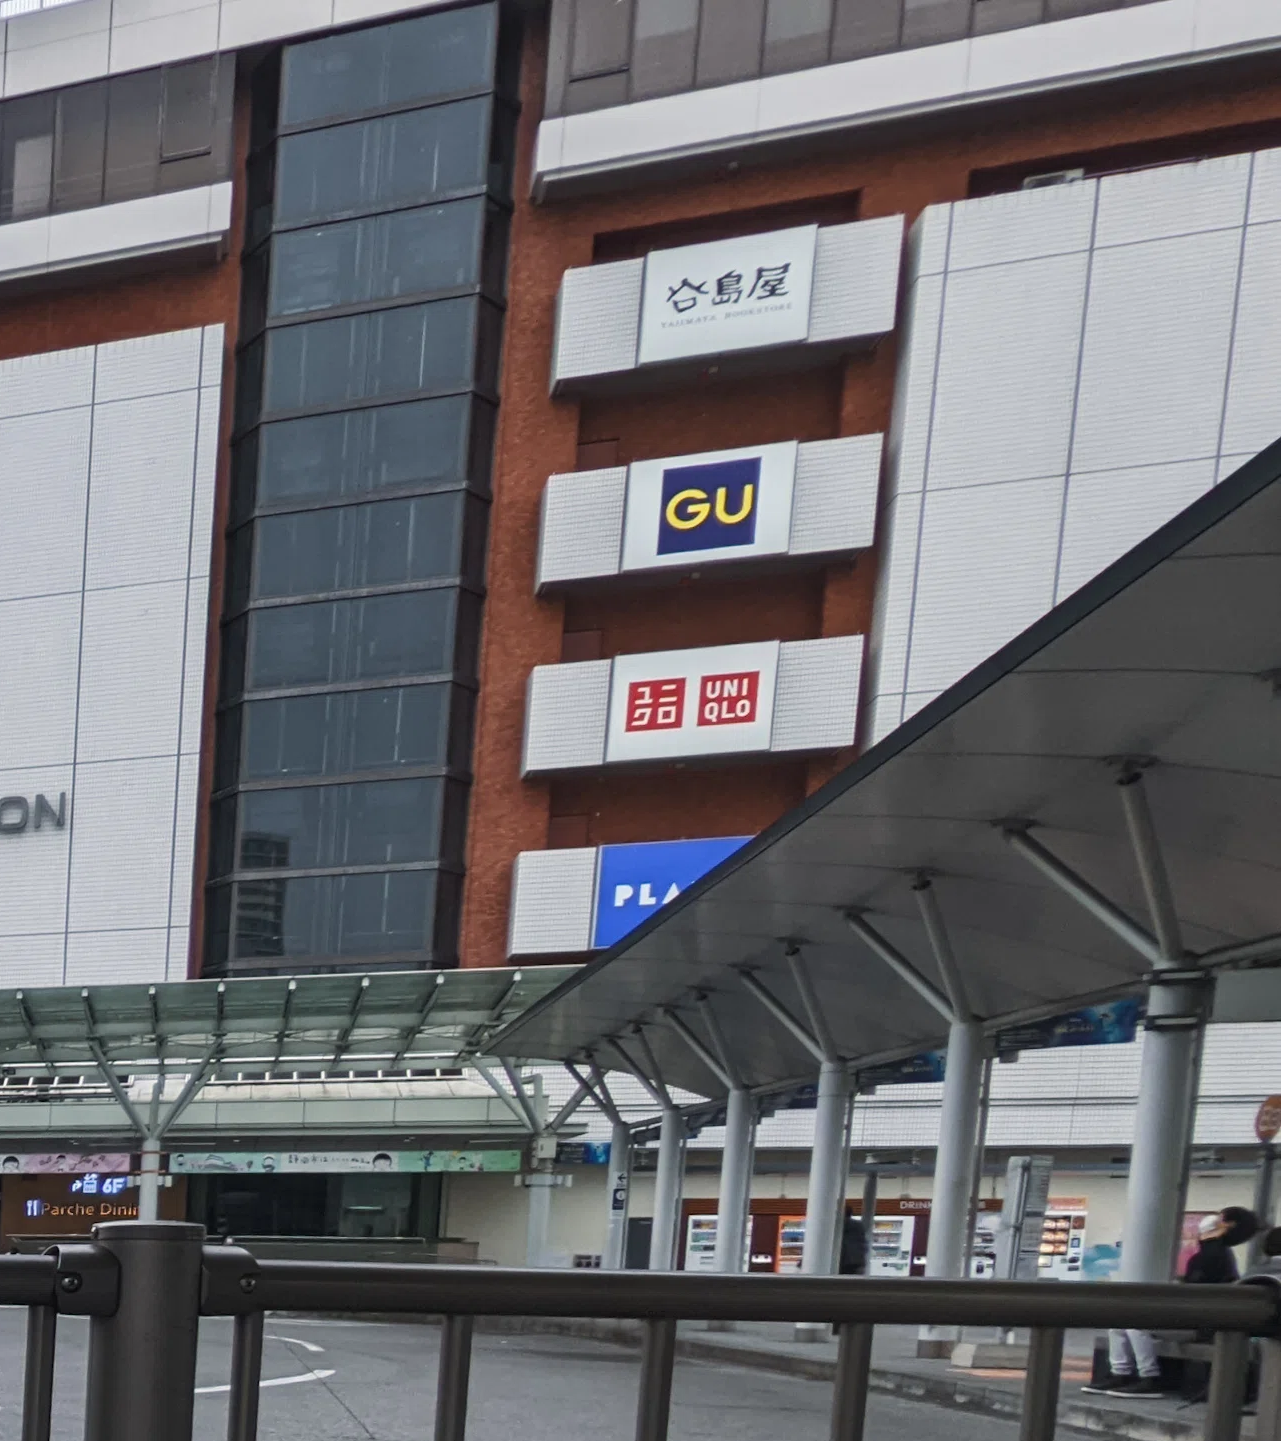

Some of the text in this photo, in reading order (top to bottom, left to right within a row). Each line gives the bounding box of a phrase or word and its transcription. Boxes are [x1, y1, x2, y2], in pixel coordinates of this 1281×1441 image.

[666, 262, 791, 313] 谷島屋
[724, 303, 792, 319] BOOKSTORE
[665, 484, 753, 529] GU
[614, 881, 694, 907] PLA
[102, 1178, 125, 1194] 6F
[41, 1202, 95, 1216] Parche
